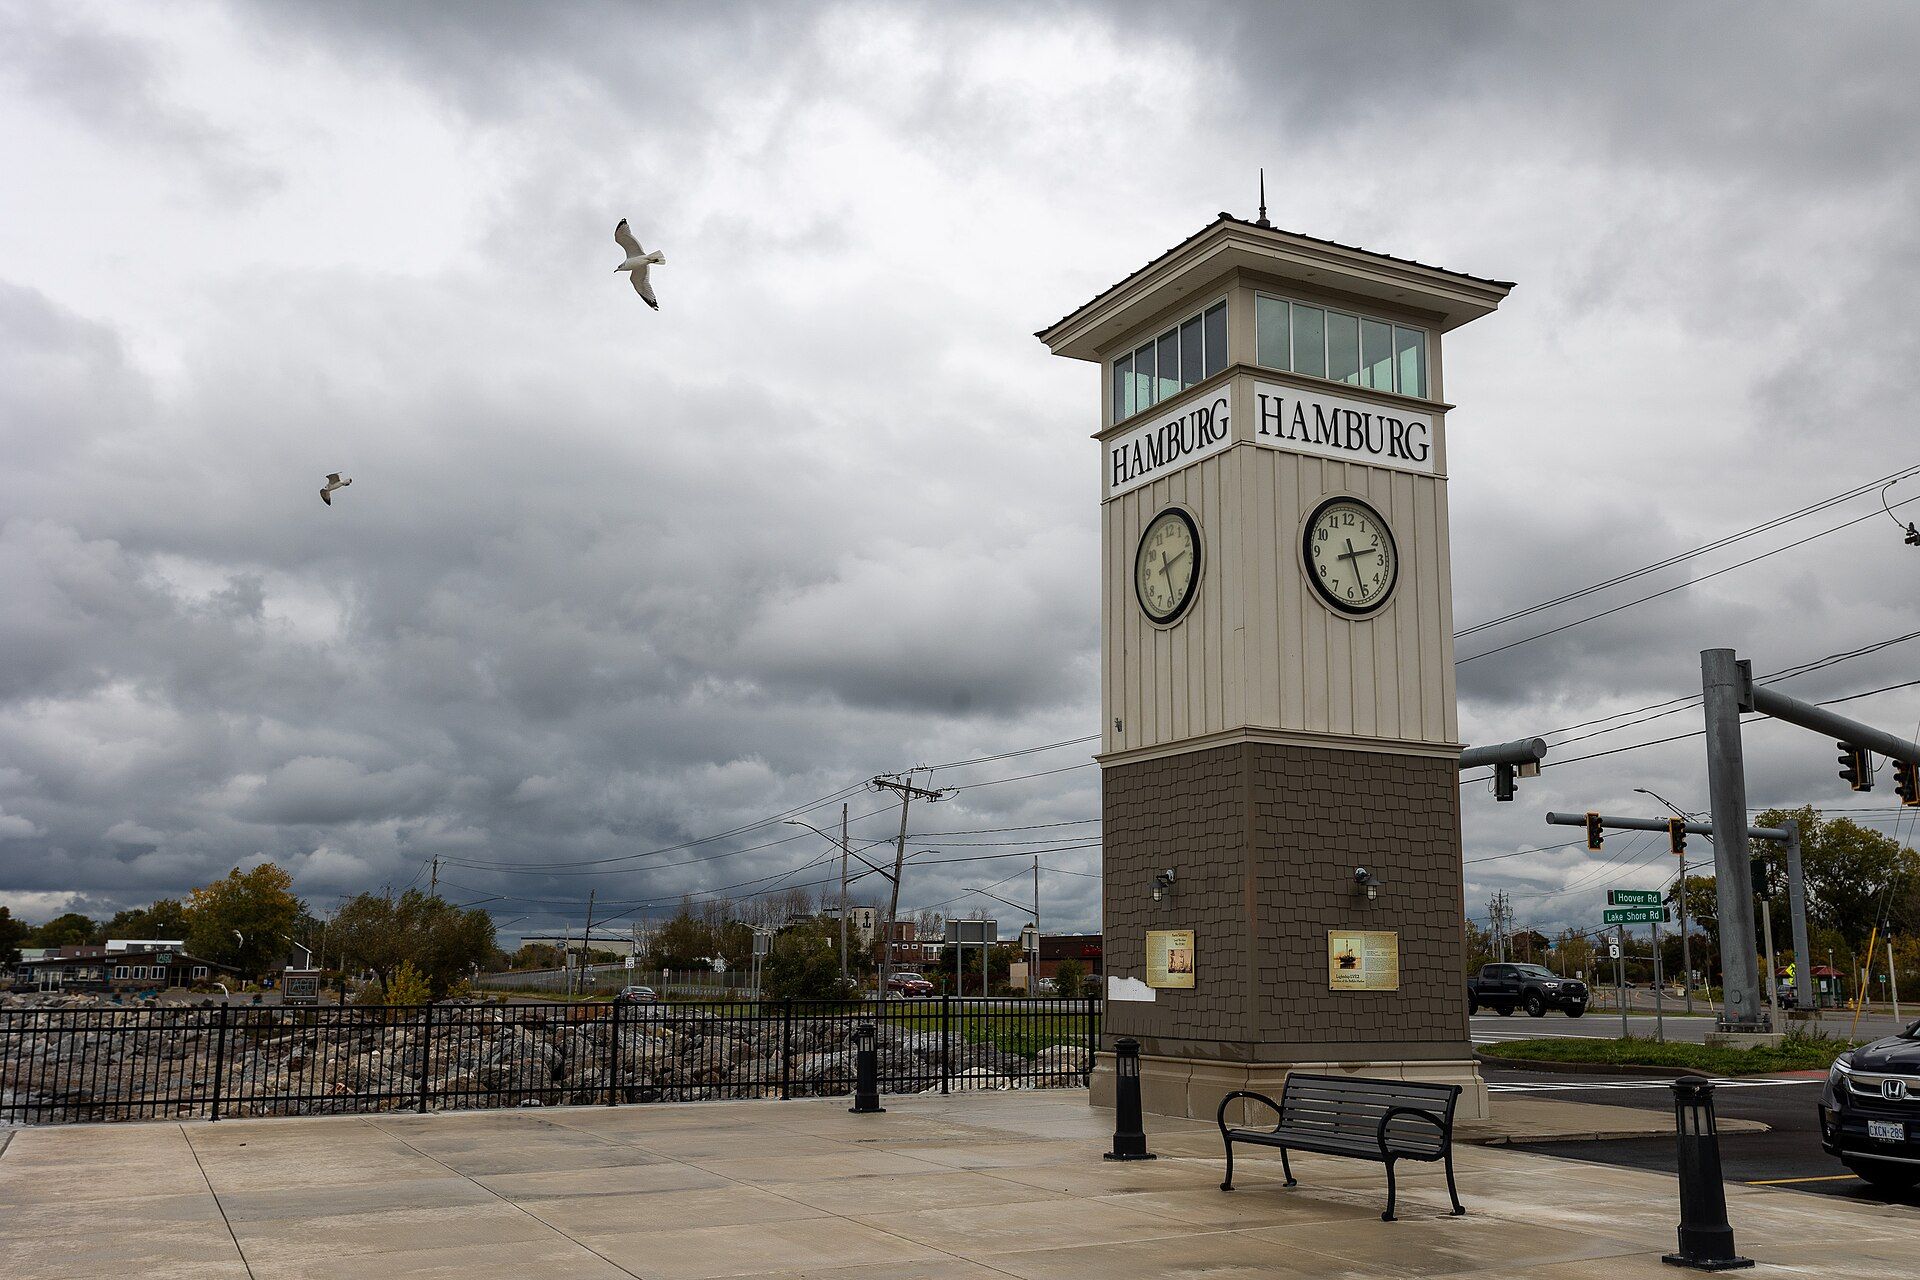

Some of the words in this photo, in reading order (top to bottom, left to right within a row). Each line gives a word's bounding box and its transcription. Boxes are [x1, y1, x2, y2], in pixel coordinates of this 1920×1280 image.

[1258, 394, 1430, 462] HAMBURG
[1112, 398, 1229, 487] HAMBURG
[1329, 515, 1339, 528] 11
[1343, 513, 1355, 526] 12
[1360, 520, 1365, 532] 1
[1318, 528, 1328, 541] 10
[1371, 534, 1378, 546] 2
[1314, 545, 1320, 557] 9
[1377, 554, 1384, 566] 3
[1320, 565, 1327, 577] 8
[1373, 573, 1379, 584] 4
[1332, 580, 1339, 591] 7
[1348, 587, 1354, 598] 6
[1618, 894, 1644, 902] Hoover
[1648, 894, 1657, 902] Rd
[1607, 913, 1623, 921] Lake
[1627, 912, 1646, 920] Shore
[1650, 911, 1659, 919] Rd
